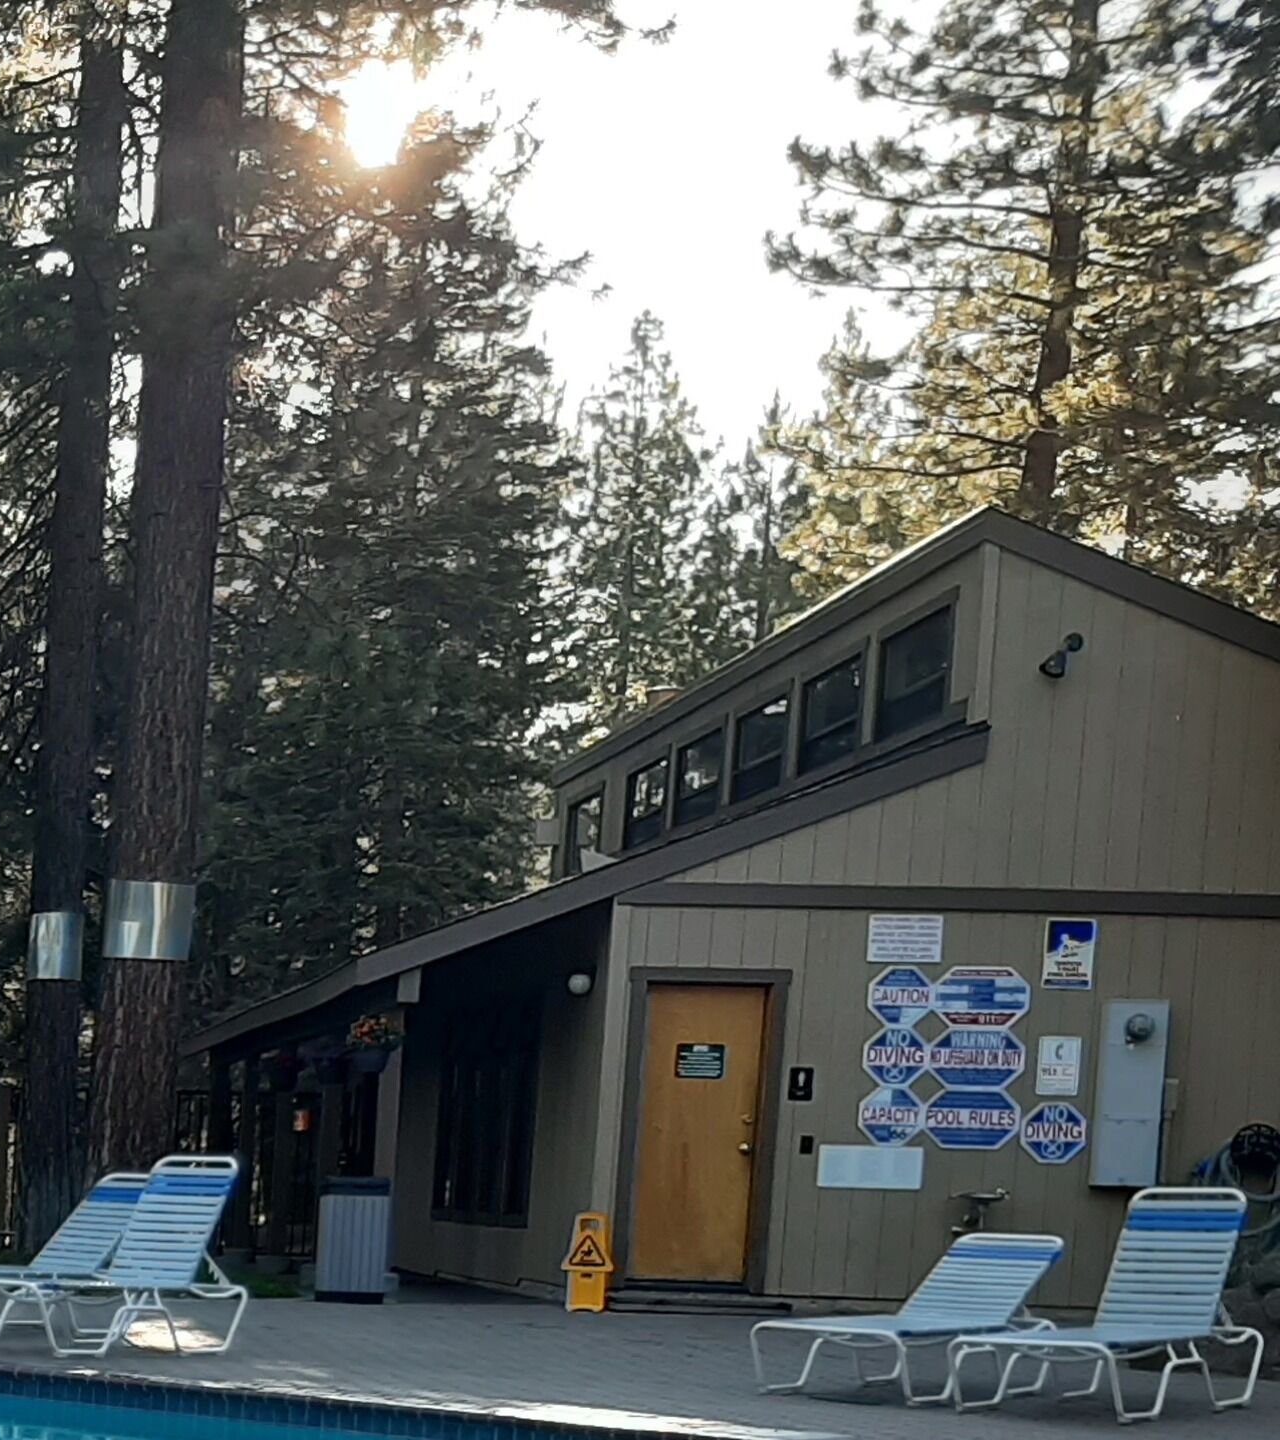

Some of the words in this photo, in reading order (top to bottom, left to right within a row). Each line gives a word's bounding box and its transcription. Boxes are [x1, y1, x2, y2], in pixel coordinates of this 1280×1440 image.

[872, 988, 930, 1003] CAUTION
[886, 1030, 911, 1047] NO
[950, 1031, 1007, 1048] WARNING
[867, 1047, 924, 1064] DIVING
[930, 1050, 941, 1063] NO
[944, 1050, 985, 1065] LIFEGUARD
[988, 1050, 999, 1065] ON
[1001, 1050, 1022, 1066] DUTY
[862, 1107, 919, 1124] CAPACITY
[927, 1109, 963, 1125] POOL
[969, 1110, 1017, 1126] RULES
[1044, 1105, 1068, 1122] NO
[1025, 1123, 1083, 1140] DIVING
